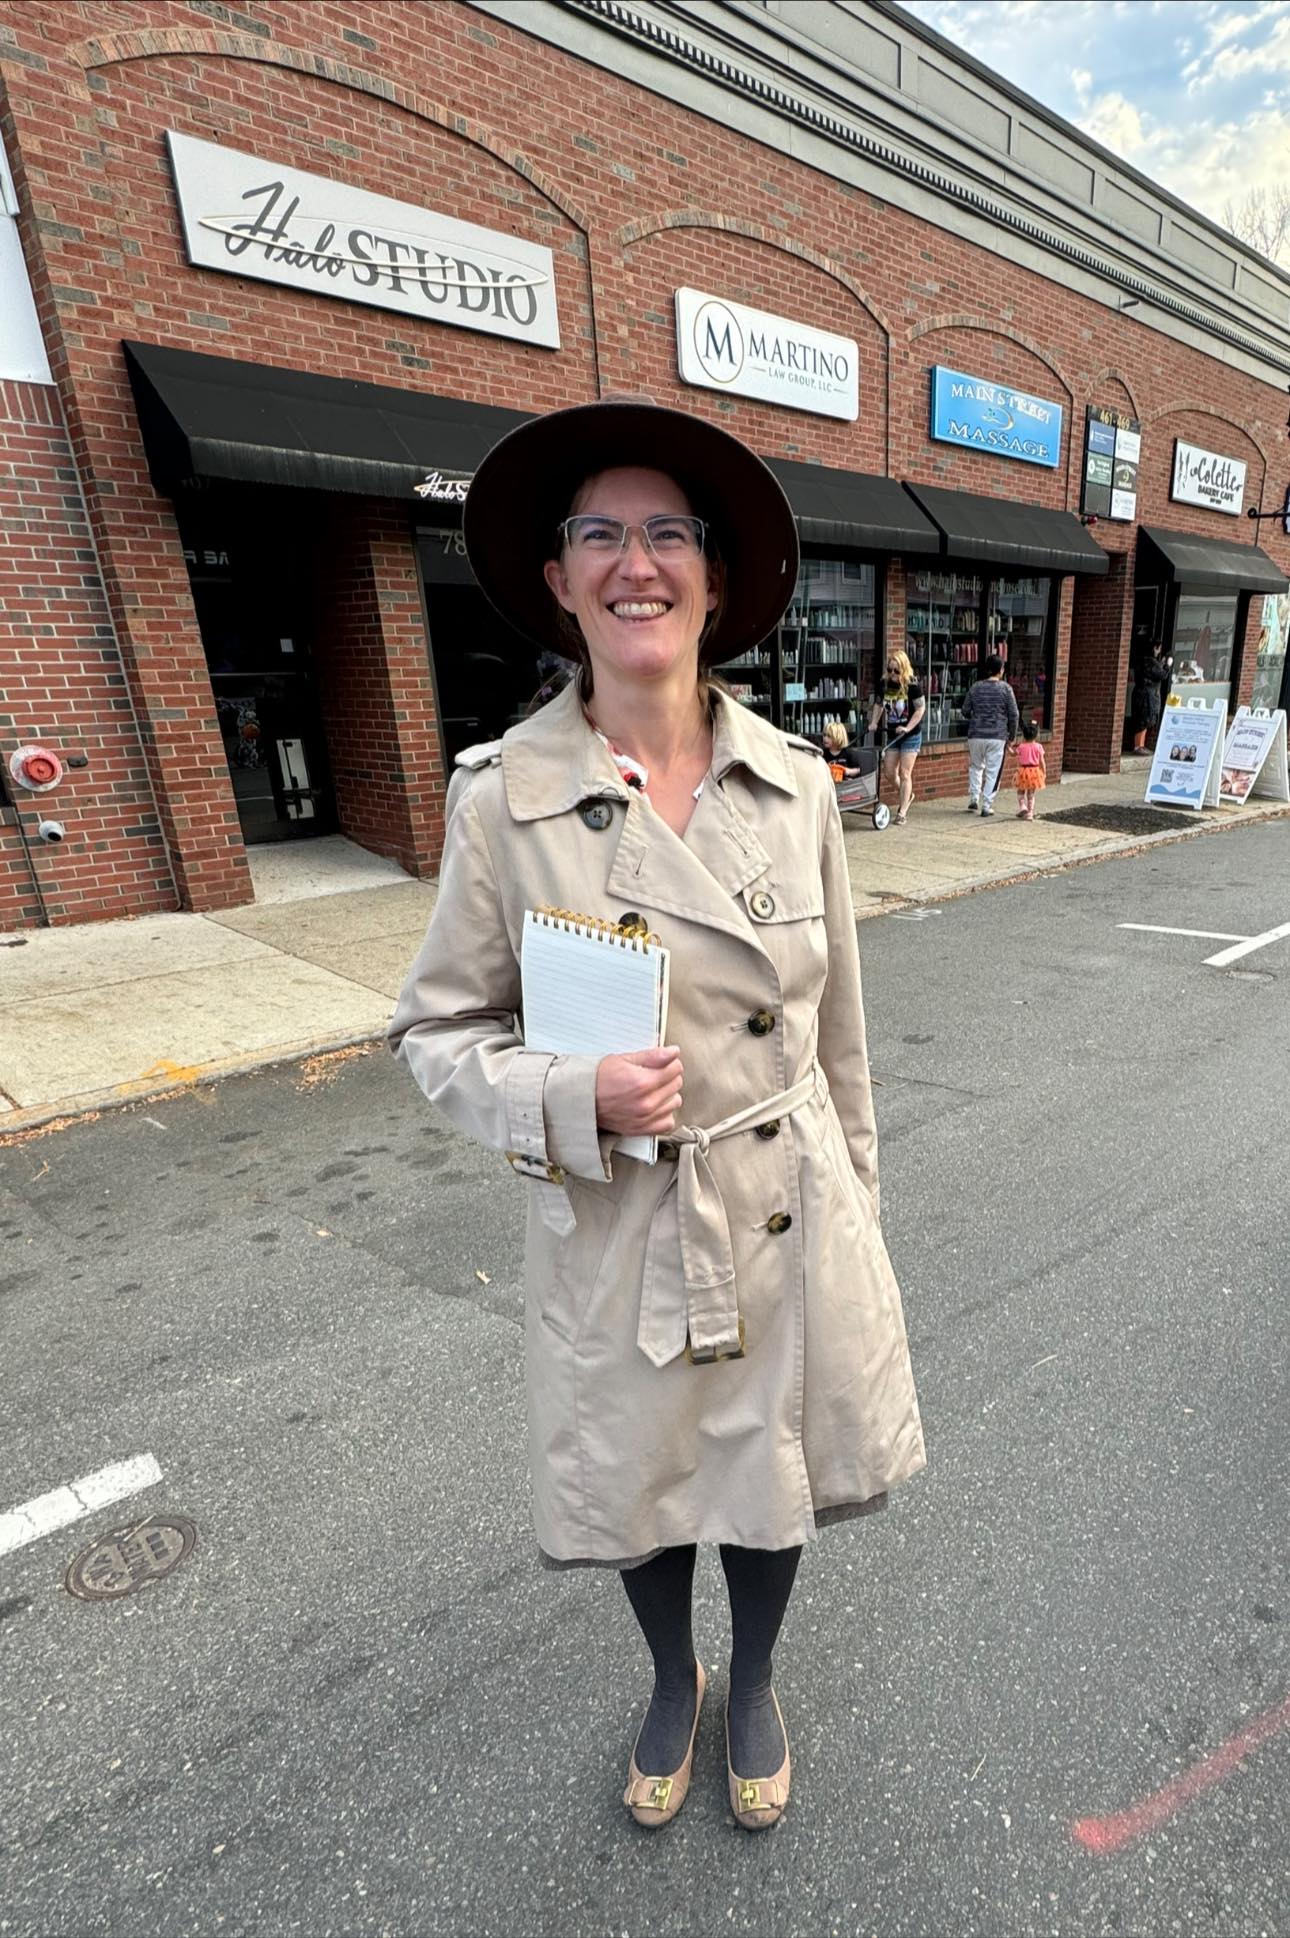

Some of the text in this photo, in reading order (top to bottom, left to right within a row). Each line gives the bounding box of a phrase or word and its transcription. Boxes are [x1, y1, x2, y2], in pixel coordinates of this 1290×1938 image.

[224, 181, 538, 326] Halo STUDIO
[702, 312, 738, 368] M
[748, 328, 849, 383] MARTINO
[768, 367, 786, 380] LAW
[818, 380, 833, 394] LLC
[951, 383, 1053, 425] MAIN STREET
[948, 419, 1050, 459] MASSAGE
[1190, 456, 1243, 493] Colette
[1198, 484, 1220, 498] BAKERY
